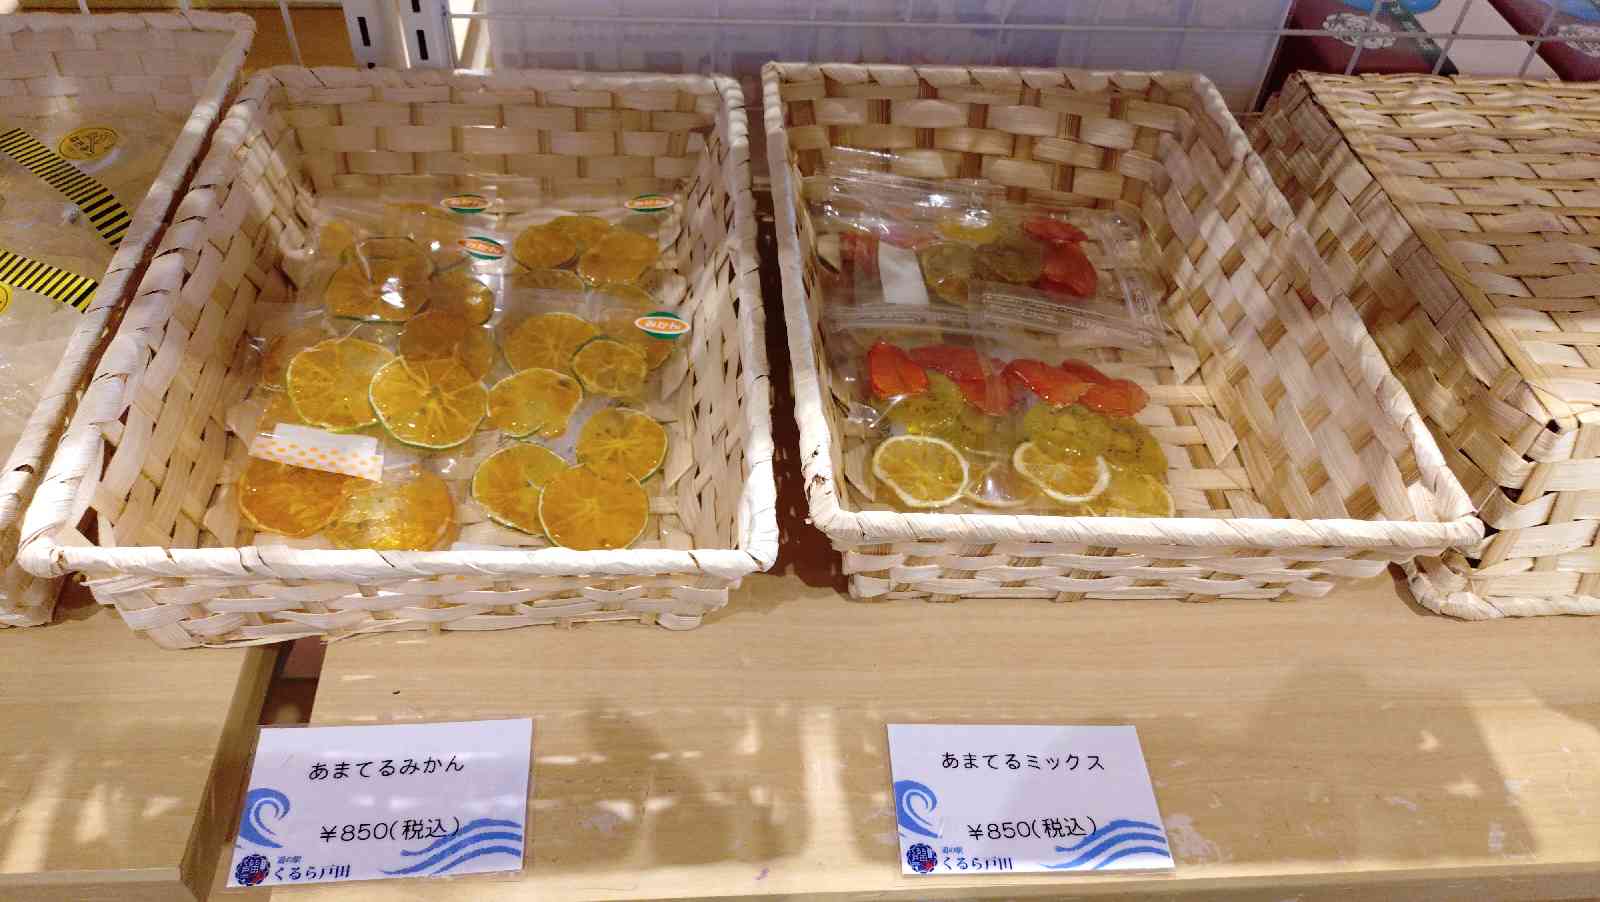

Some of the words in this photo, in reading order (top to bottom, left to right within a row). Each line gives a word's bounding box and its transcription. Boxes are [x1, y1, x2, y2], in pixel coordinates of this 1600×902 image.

[308, 755, 465, 781] あまてるみかん
[941, 751, 1105, 771] あまてるミックス
